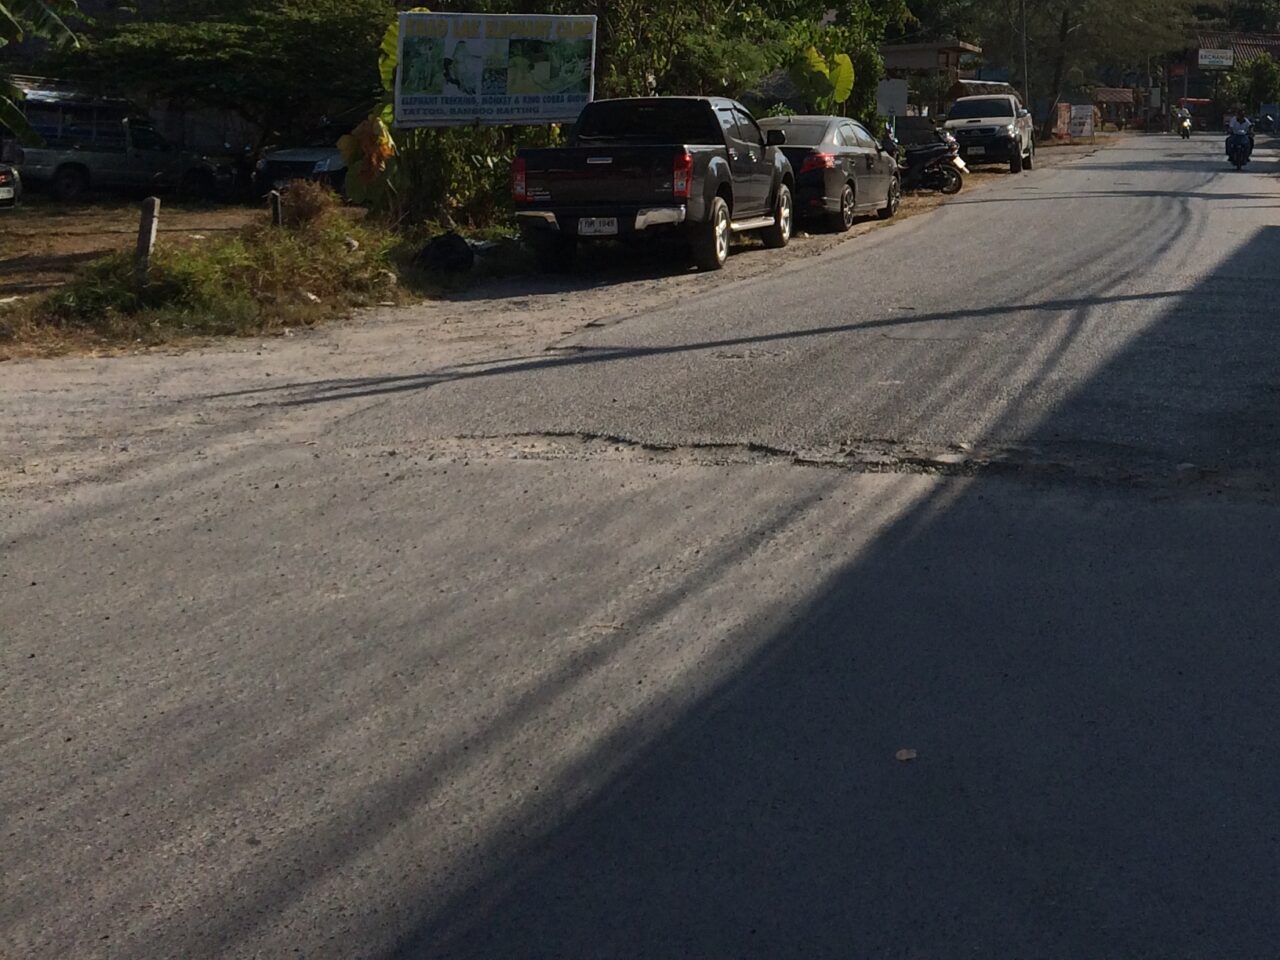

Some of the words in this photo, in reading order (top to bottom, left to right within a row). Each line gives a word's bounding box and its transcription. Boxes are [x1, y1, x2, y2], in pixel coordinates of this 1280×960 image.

[401, 95, 438, 105] ELEPHANT
[481, 95, 513, 105] MONKEY
[542, 95, 565, 104] COBRA
[449, 107, 494, 116] BAMBOO
[496, 107, 540, 115] RAFTING
